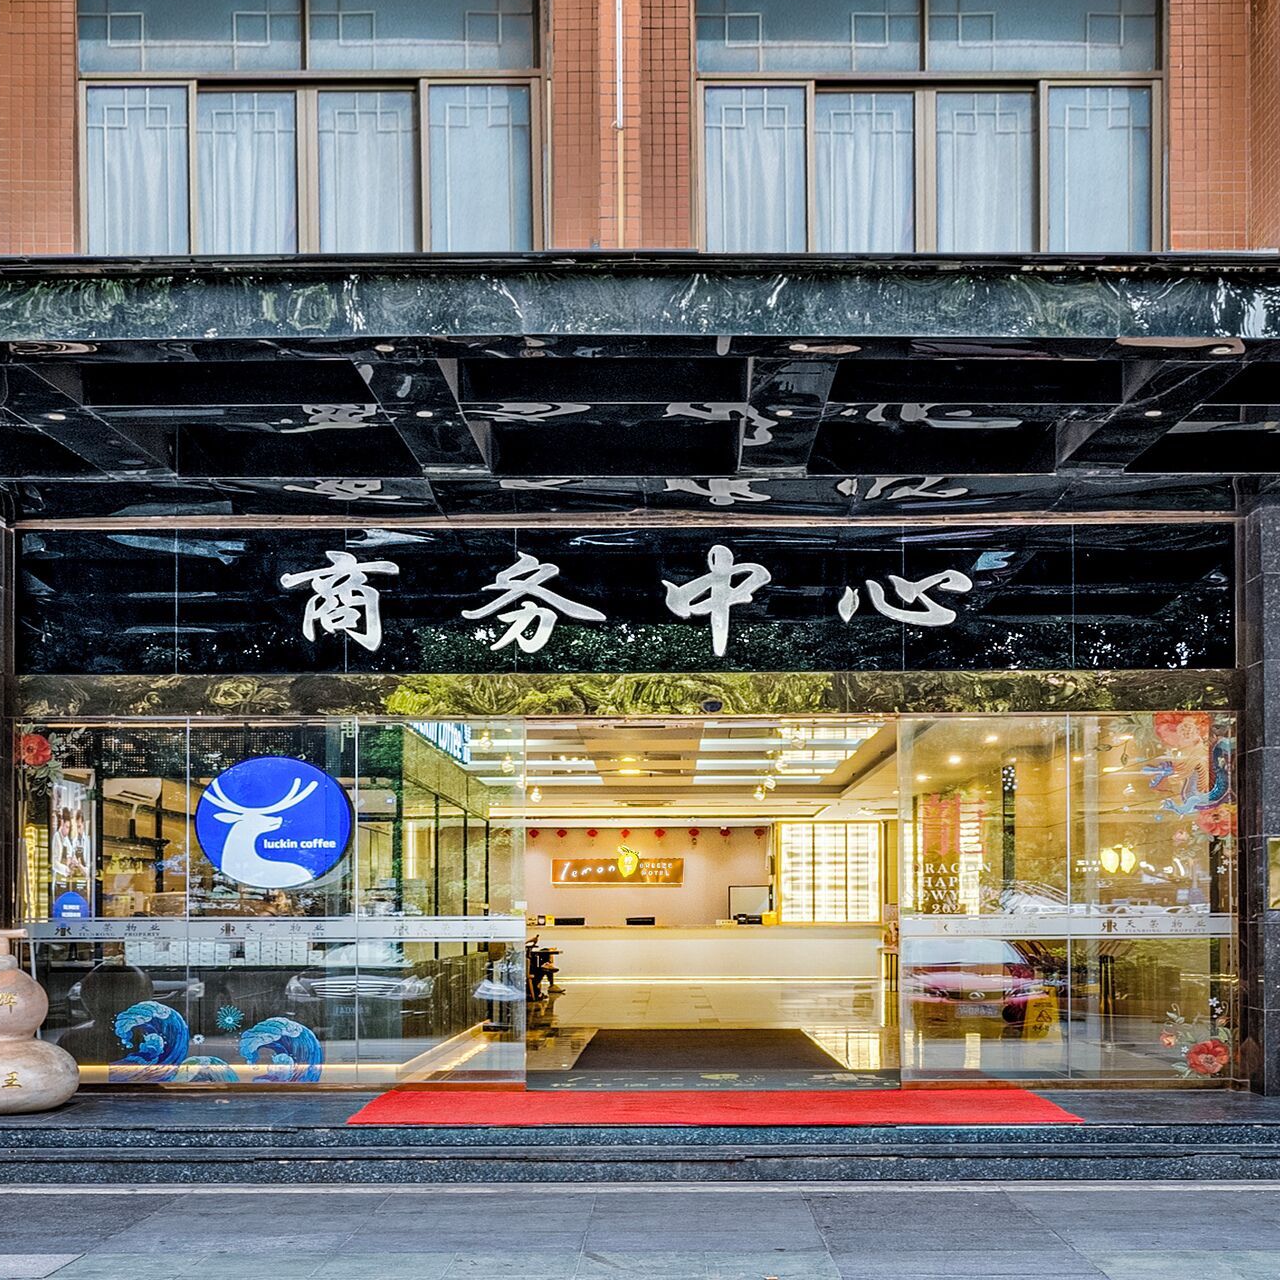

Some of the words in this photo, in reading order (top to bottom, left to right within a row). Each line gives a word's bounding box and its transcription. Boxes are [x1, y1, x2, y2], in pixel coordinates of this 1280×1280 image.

[280, 545, 973, 657] 商务中心
[263, 838, 298, 849] luckin
[300, 838, 337, 849] coffee
[560, 861, 616, 881] lemon
